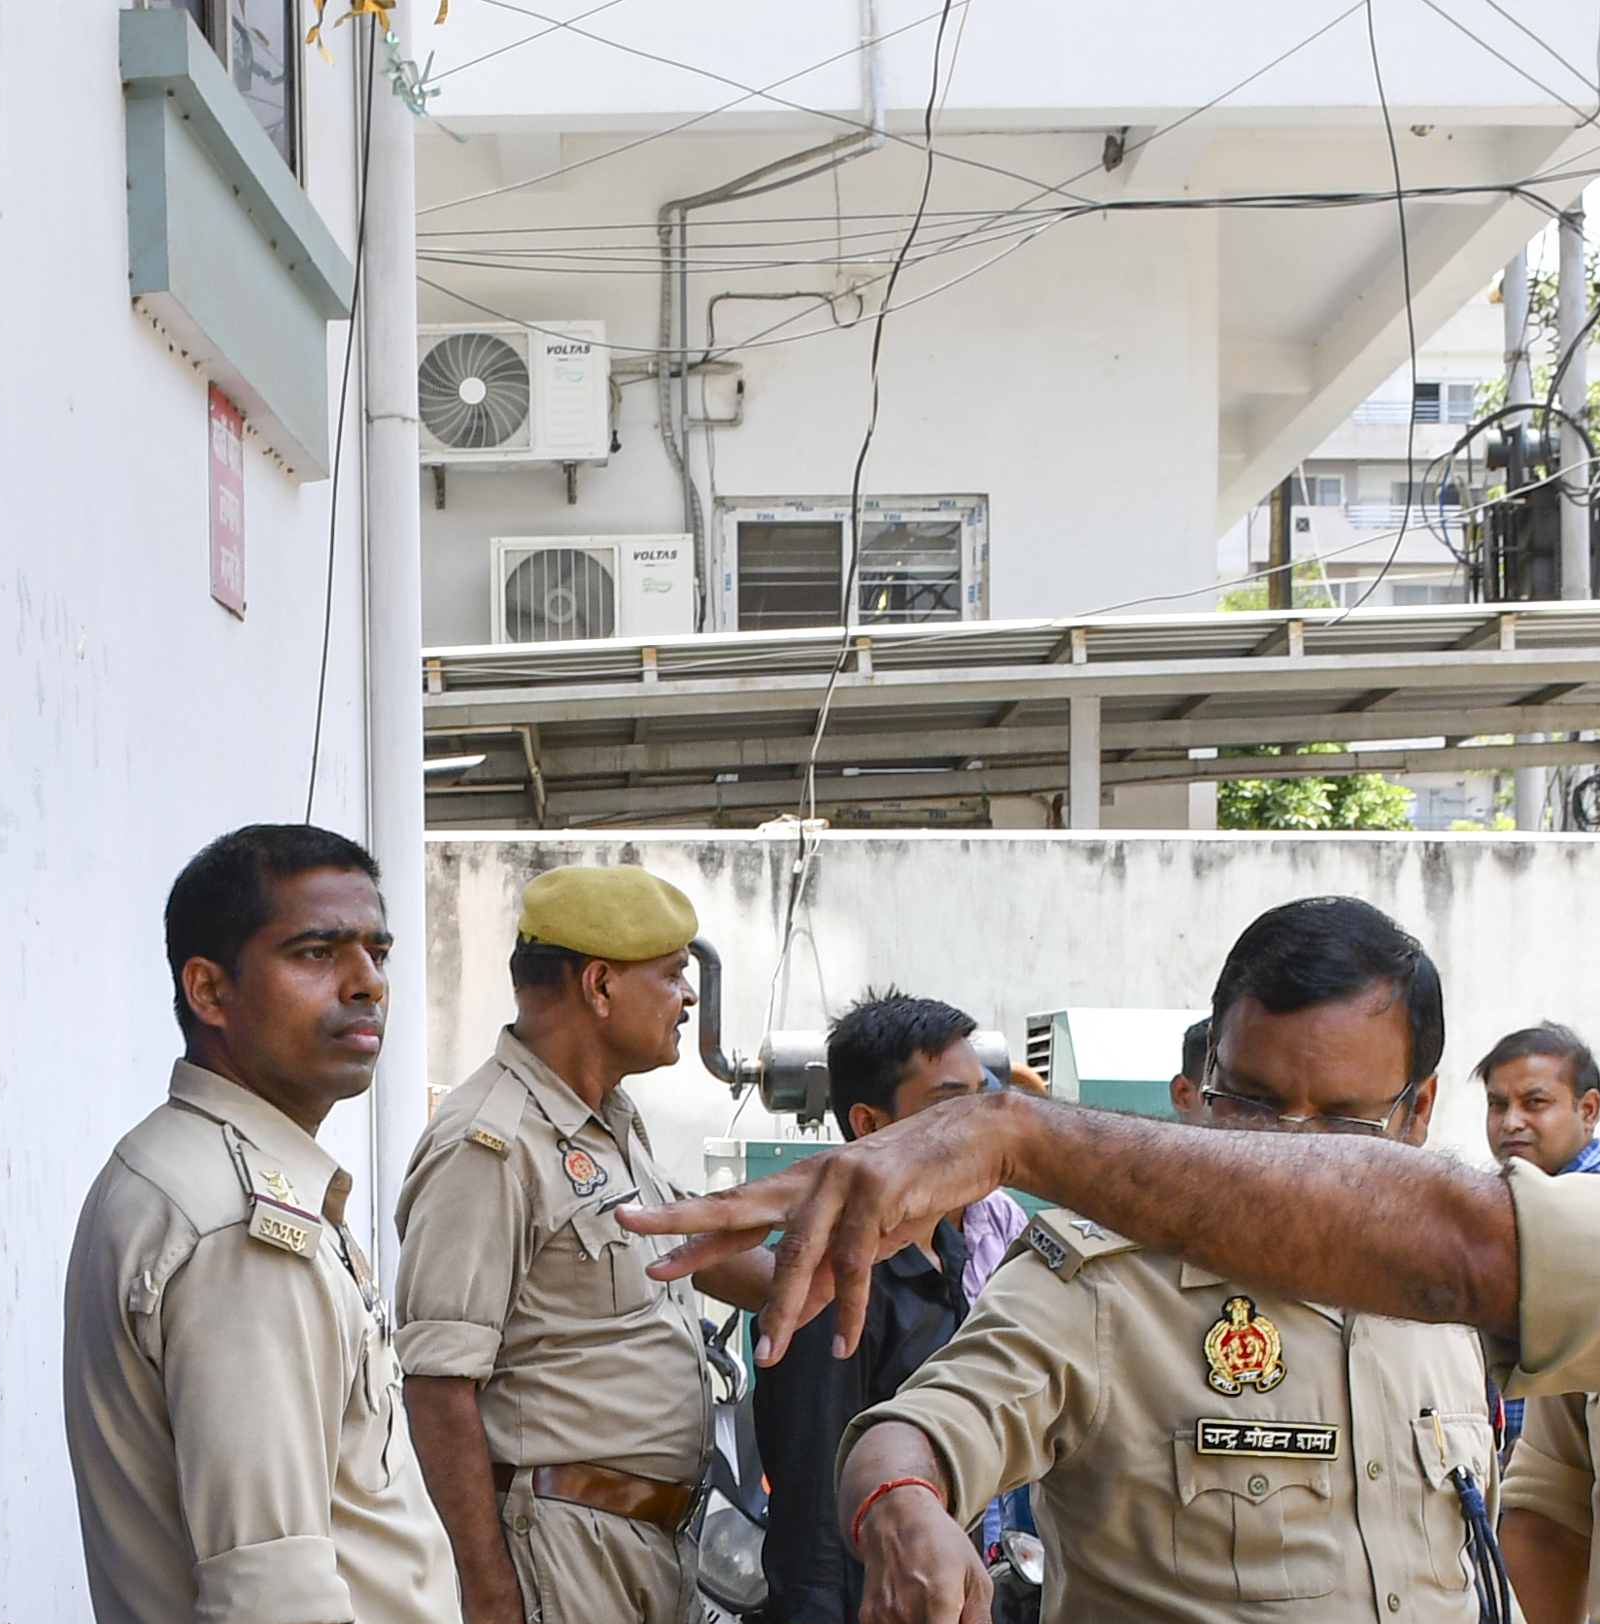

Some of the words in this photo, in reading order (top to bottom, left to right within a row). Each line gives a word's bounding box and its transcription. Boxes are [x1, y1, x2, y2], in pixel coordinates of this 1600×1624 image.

[546, 343, 592, 355] VOLTAS
[633, 549, 678, 561] VOLTAS
[1204, 1427, 1240, 1449] चन्द्र
[1243, 1426, 1292, 1449] मोहन
[1296, 1430, 1333, 1451] शर्मा
